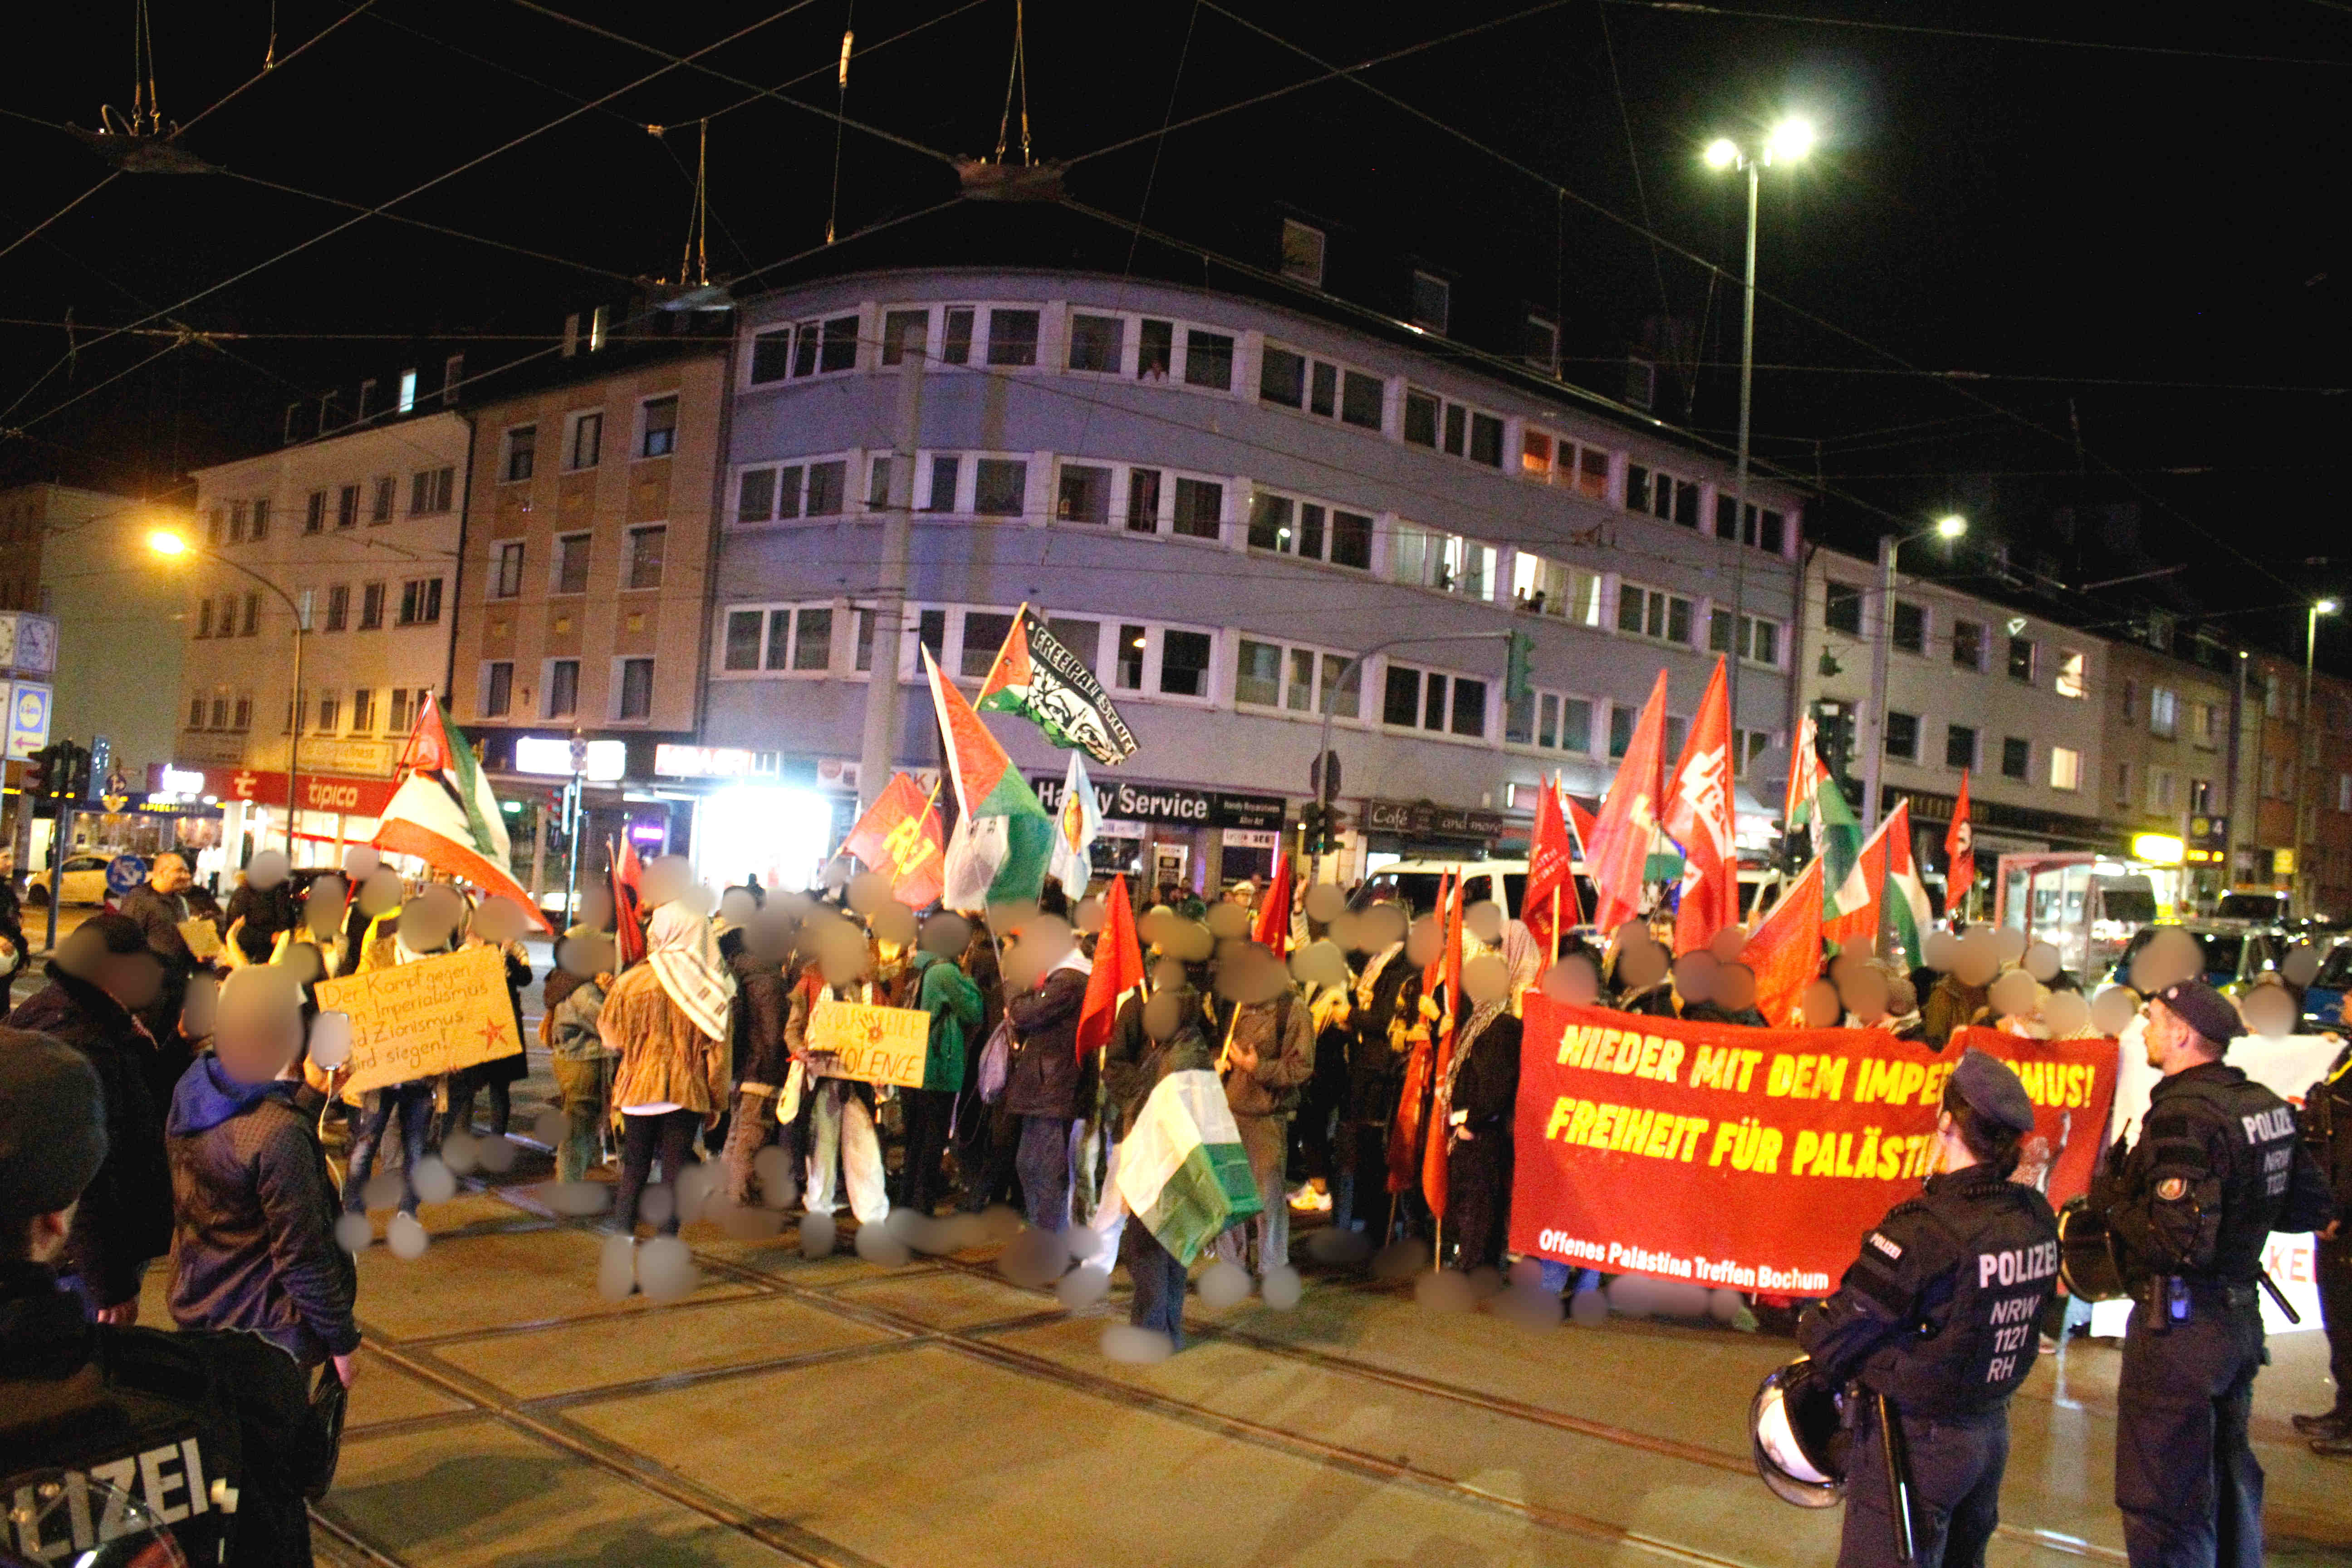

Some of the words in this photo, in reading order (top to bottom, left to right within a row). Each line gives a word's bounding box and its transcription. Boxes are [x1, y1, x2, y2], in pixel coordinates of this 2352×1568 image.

[1032, 627, 1074, 674] FREE
[308, 776, 358, 810] tipico
[1038, 781, 1114, 816] Hay
[1119, 787, 1208, 820] Service
[1372, 805, 1408, 830] Café
[323, 986, 358, 1008] Der
[366, 965, 423, 998] Kampf
[427, 965, 470, 990] gegen
[373, 1011, 465, 1044] Zionismus
[386, 1028, 448, 1069] siegen!
[1557, 1024, 1685, 1083] NIEDER
[1689, 1044, 1764, 1093] MIT
[1765, 1053, 1849, 1101] DEM
[1854, 1056, 2096, 1108] IMPEMUS!
[1545, 1096, 1710, 1163] FREIHEIT
[1709, 1116, 1784, 1174] FÜR
[1539, 1228, 1605, 1262] Offenes
[1695, 1257, 1755, 1287] Treffen
[1758, 1265, 1829, 1291] Bochum
[1869, 1232, 1902, 1260] POLIZEI
[1979, 1240, 2058, 1289] POLIZEI
[1989, 1294, 2041, 1326] NRW
[1994, 1323, 2030, 1354] 1121
[1986, 1354, 2017, 1384] RH
[0, 1437, 210, 1563] LIZEI
